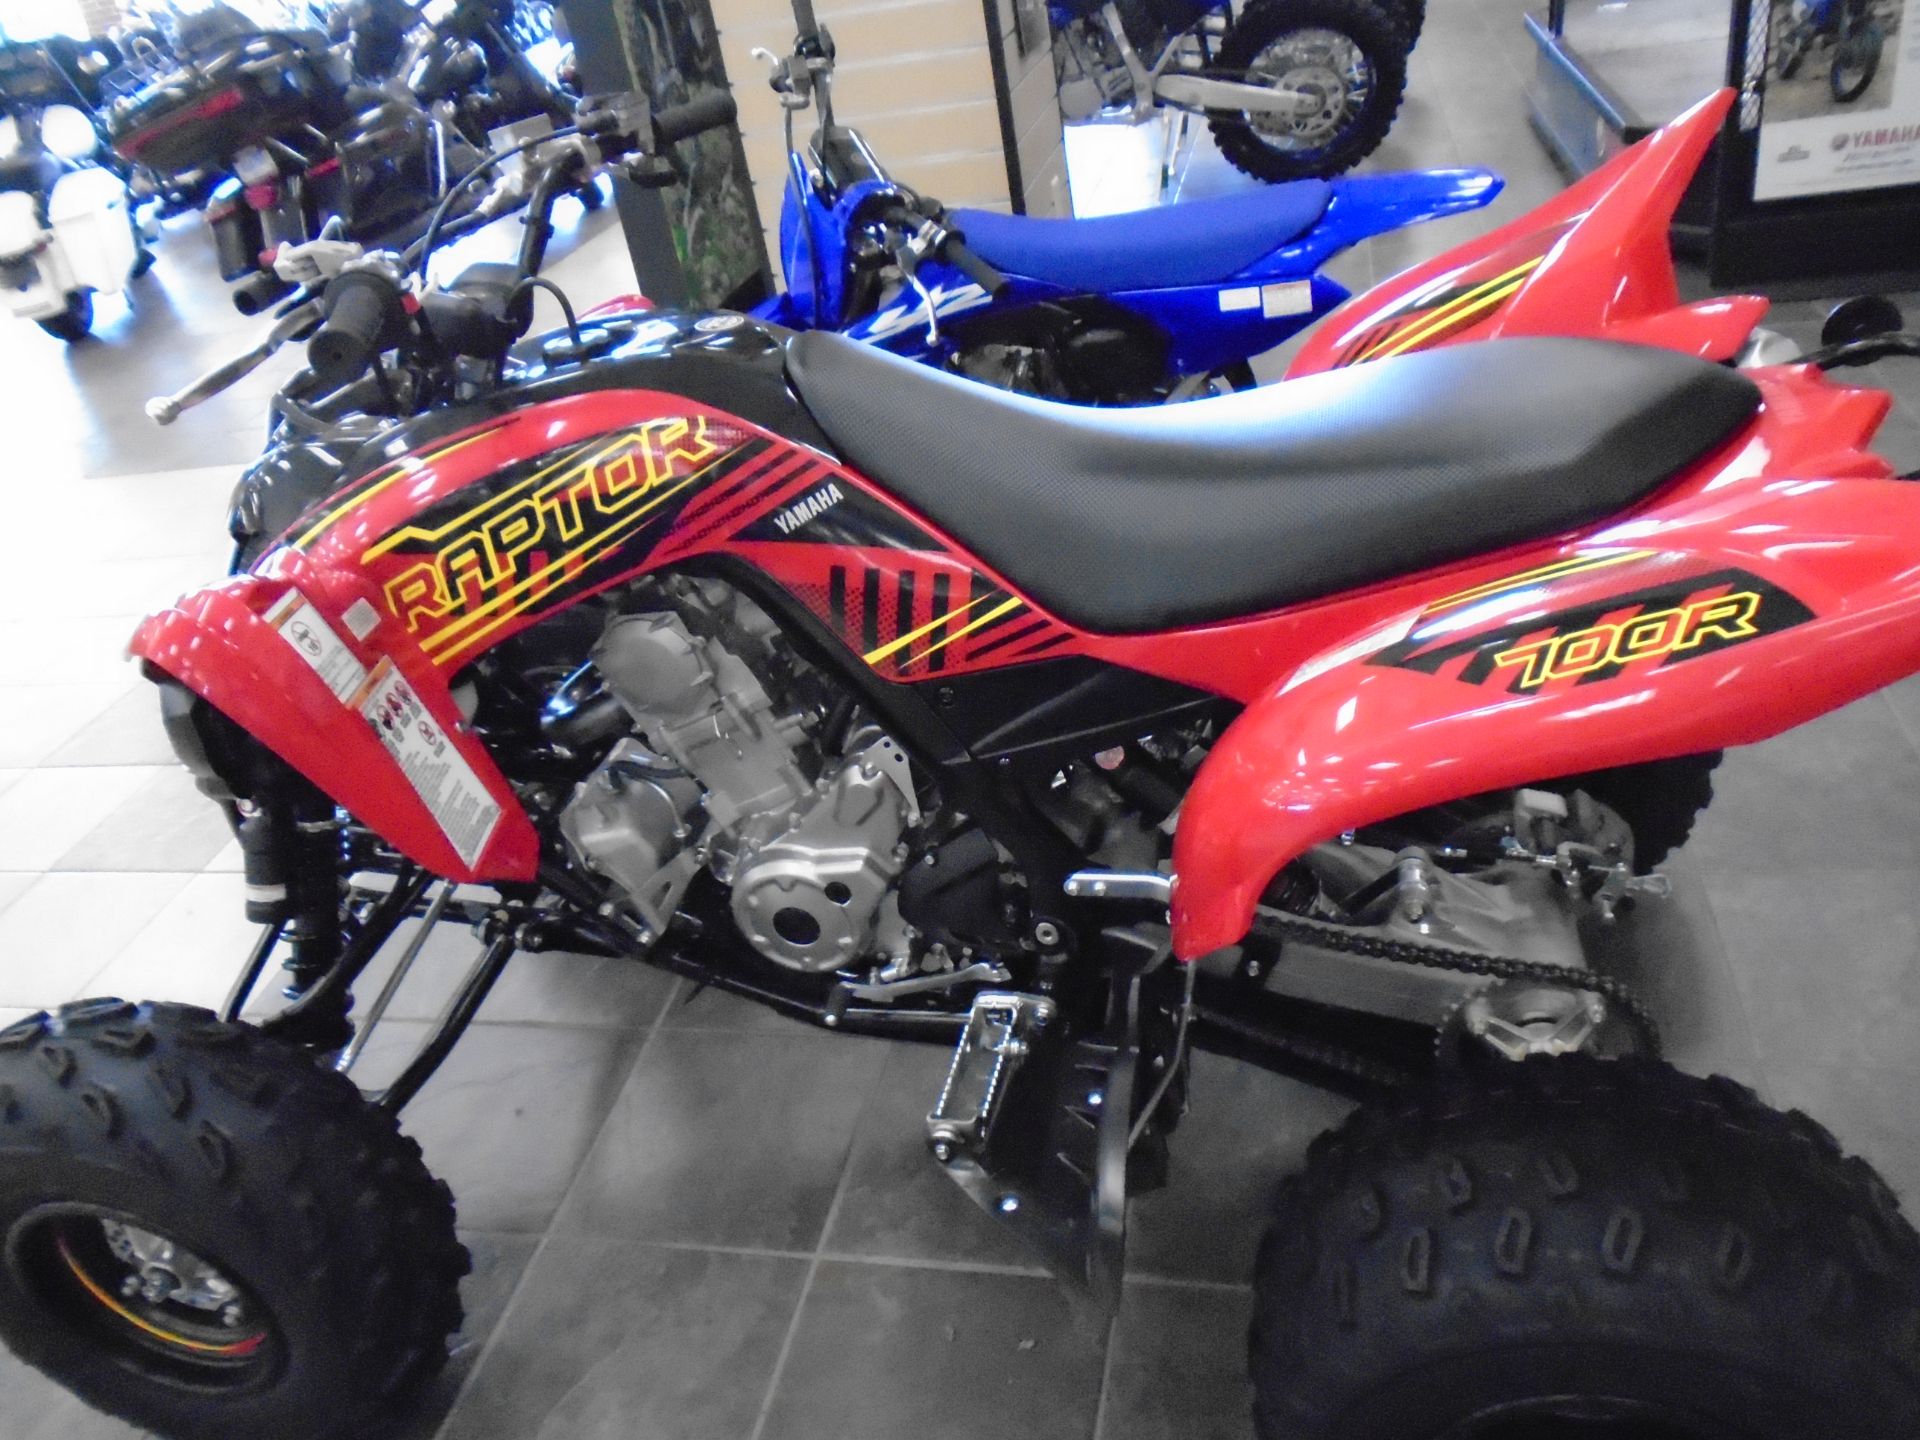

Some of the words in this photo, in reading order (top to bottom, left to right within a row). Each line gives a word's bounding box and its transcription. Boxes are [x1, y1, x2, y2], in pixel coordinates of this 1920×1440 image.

[383, 415, 717, 633] RAPTOR
[774, 484, 844, 534] YAMAHA
[1494, 591, 1762, 689] 700R
